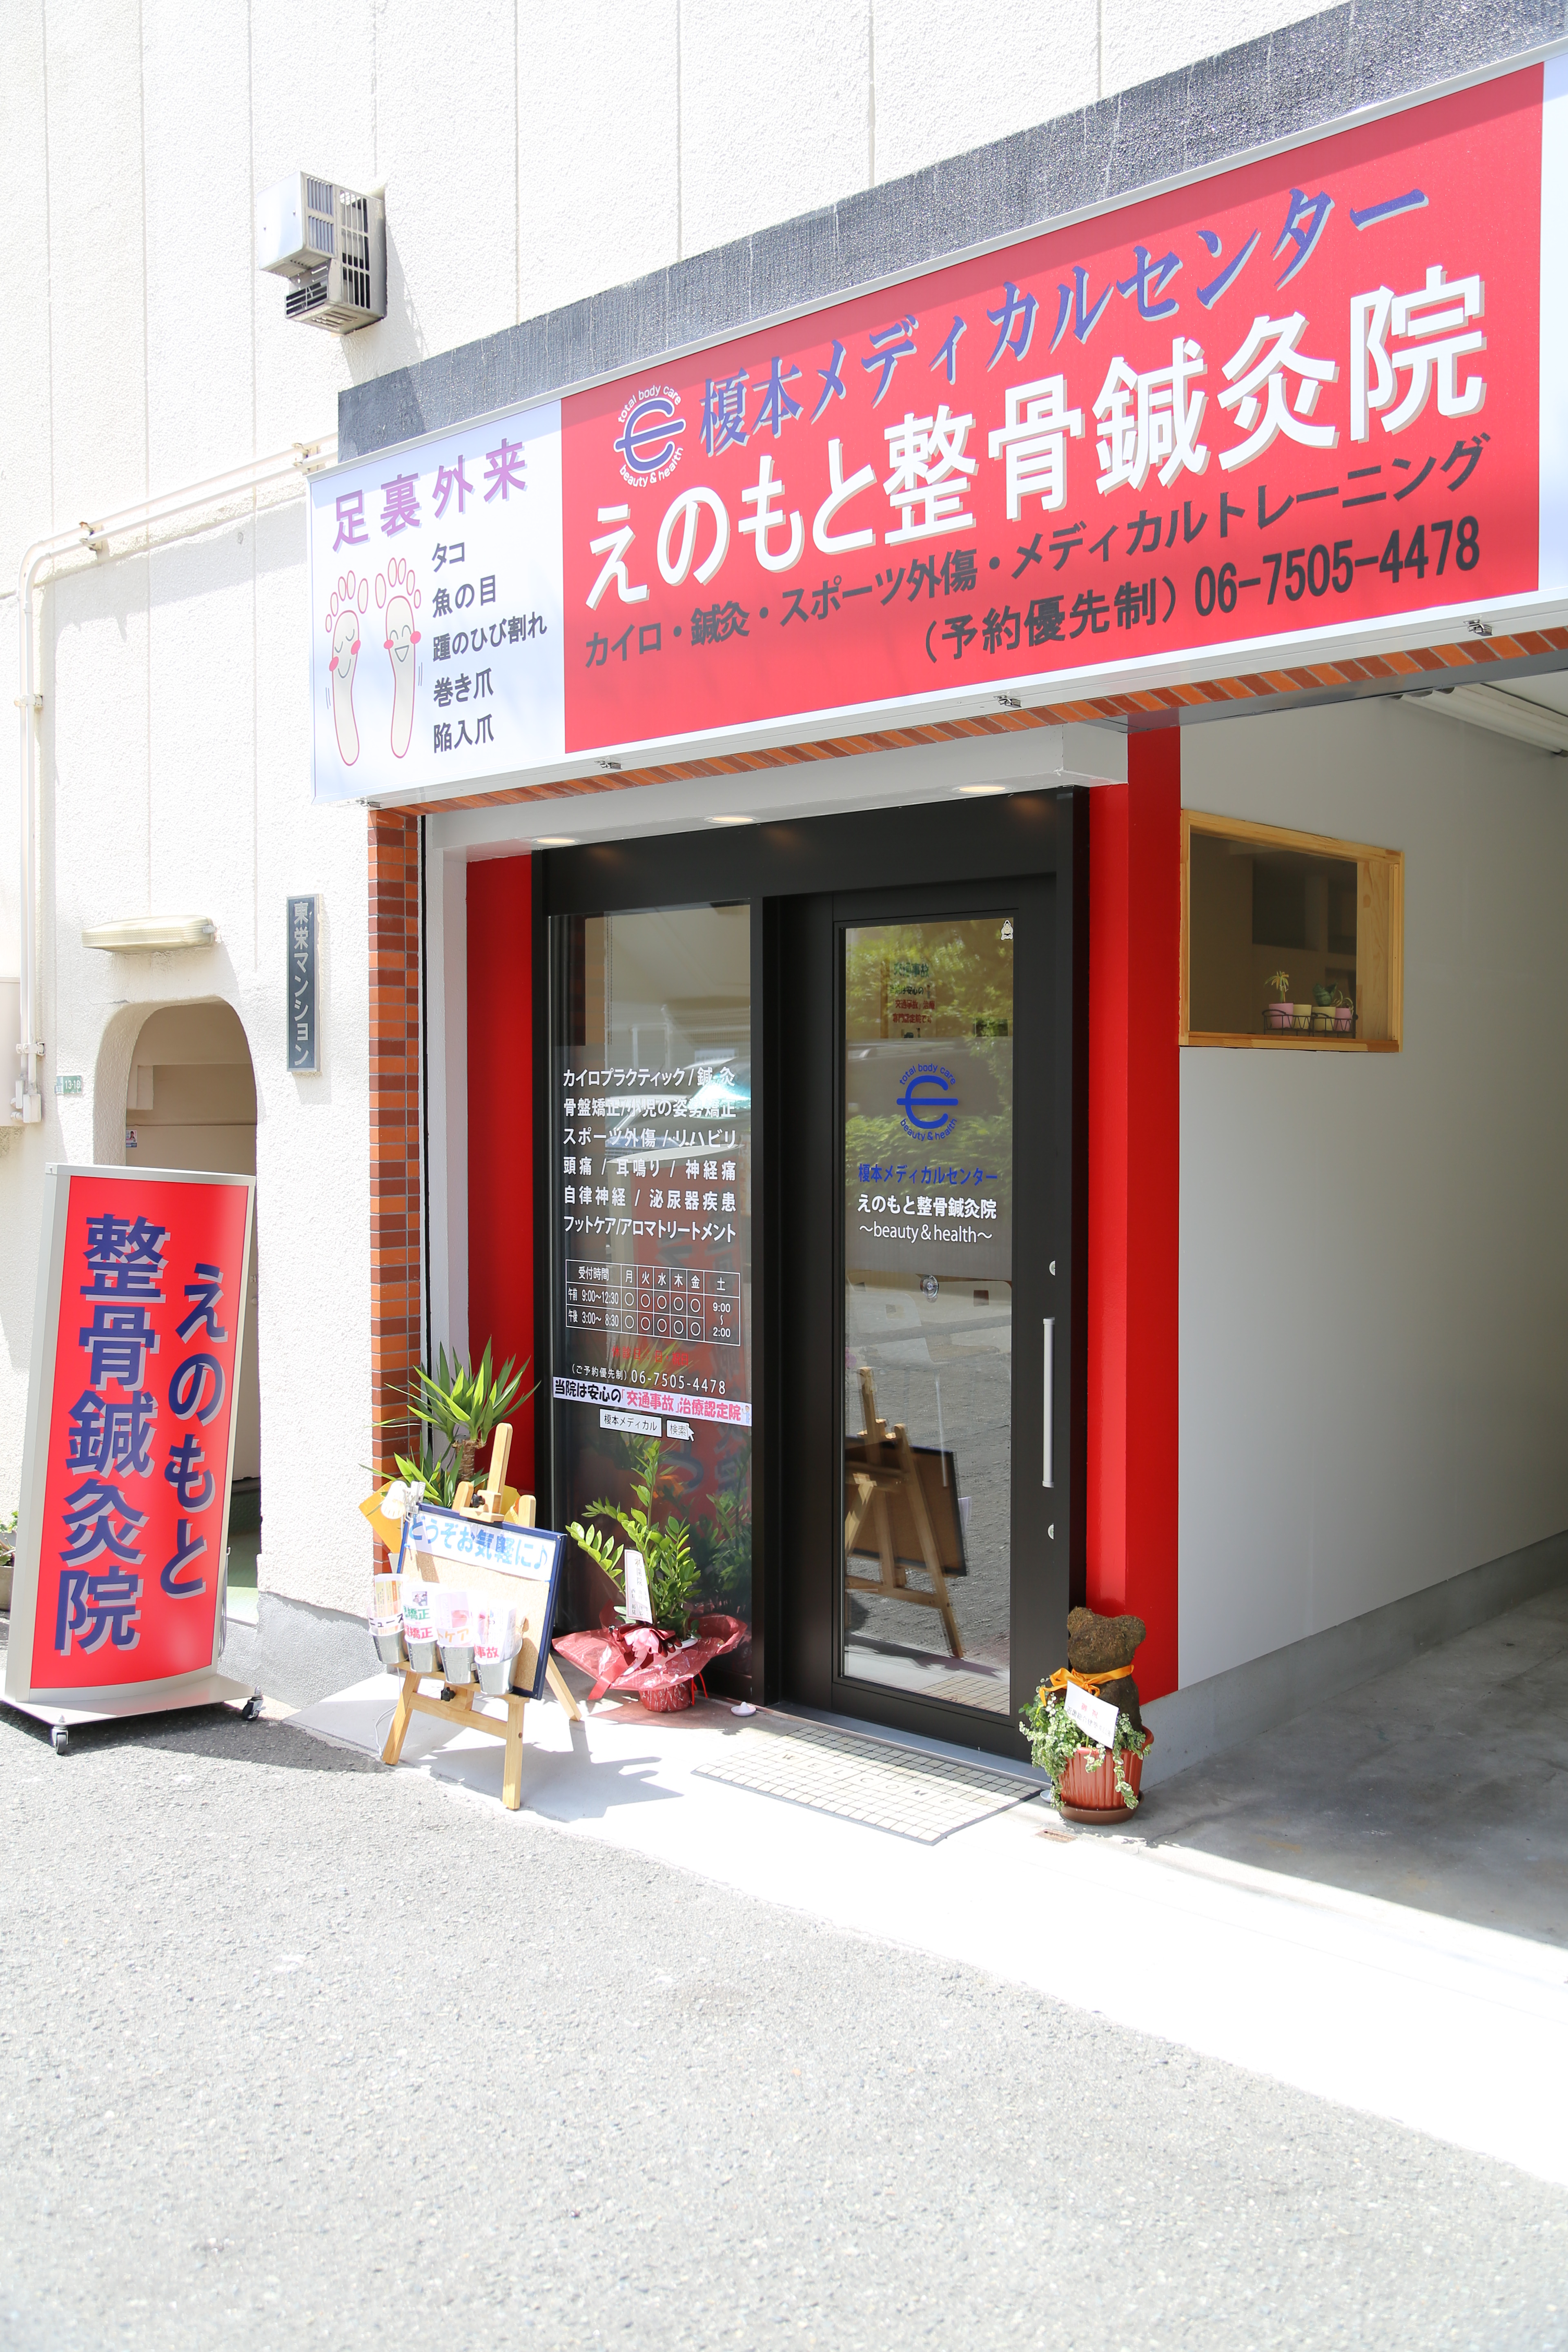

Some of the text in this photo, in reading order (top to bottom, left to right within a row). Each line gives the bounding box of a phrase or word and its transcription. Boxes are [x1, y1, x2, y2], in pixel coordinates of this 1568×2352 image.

[699, 187, 1429, 457] 榎本メディカルセンター
[618, 385, 681, 423] total body care
[585, 264, 1486, 610] えのもと整骨鍼灸院
[619, 447, 684, 487] beauty & health
[332, 438, 528, 552] 足裏外来
[432, 543, 465, 572] タコ
[433, 575, 496, 618] 魚の目
[433, 611, 547, 662] 踵のひび割れ
[434, 668, 494, 708] 巻き爪
[434, 714, 494, 753] 陥入爪
[294, 902, 309, 1066] 東栄マンション
[900, 1063, 956, 1085] total body care
[900, 1118, 958, 1141] beauty & health
[858, 1163, 998, 1186] 榎本メディカルセンター
[857, 1194, 997, 1219] えのもと整骨鍼灸院
[578, 1266, 609, 1281] 受付時間
[626, 1270, 633, 1283] 月
[641, 1271, 650, 1285] 火
[657, 1272, 666, 1286] 水
[674, 1274, 683, 1287] 木
[691, 1275, 700, 1289] 金
[716, 1277, 726, 1291] 土
[568, 1287, 577, 1301] 午前
[568, 1309, 578, 1323] 午後
[713, 1302, 731, 1313] 9:00
[713, 1327, 731, 1338] 2:00
[631, 1369, 726, 1394] 06-7505-4478
[160, 1262, 228, 1600] えのもと
[604, 1413, 657, 1431] 榎本メディカル
[670, 1423, 686, 1436] 検索
[53, 1214, 170, 1656] 整骨鍼灸院
[474, 1644, 499, 1658] 事故
